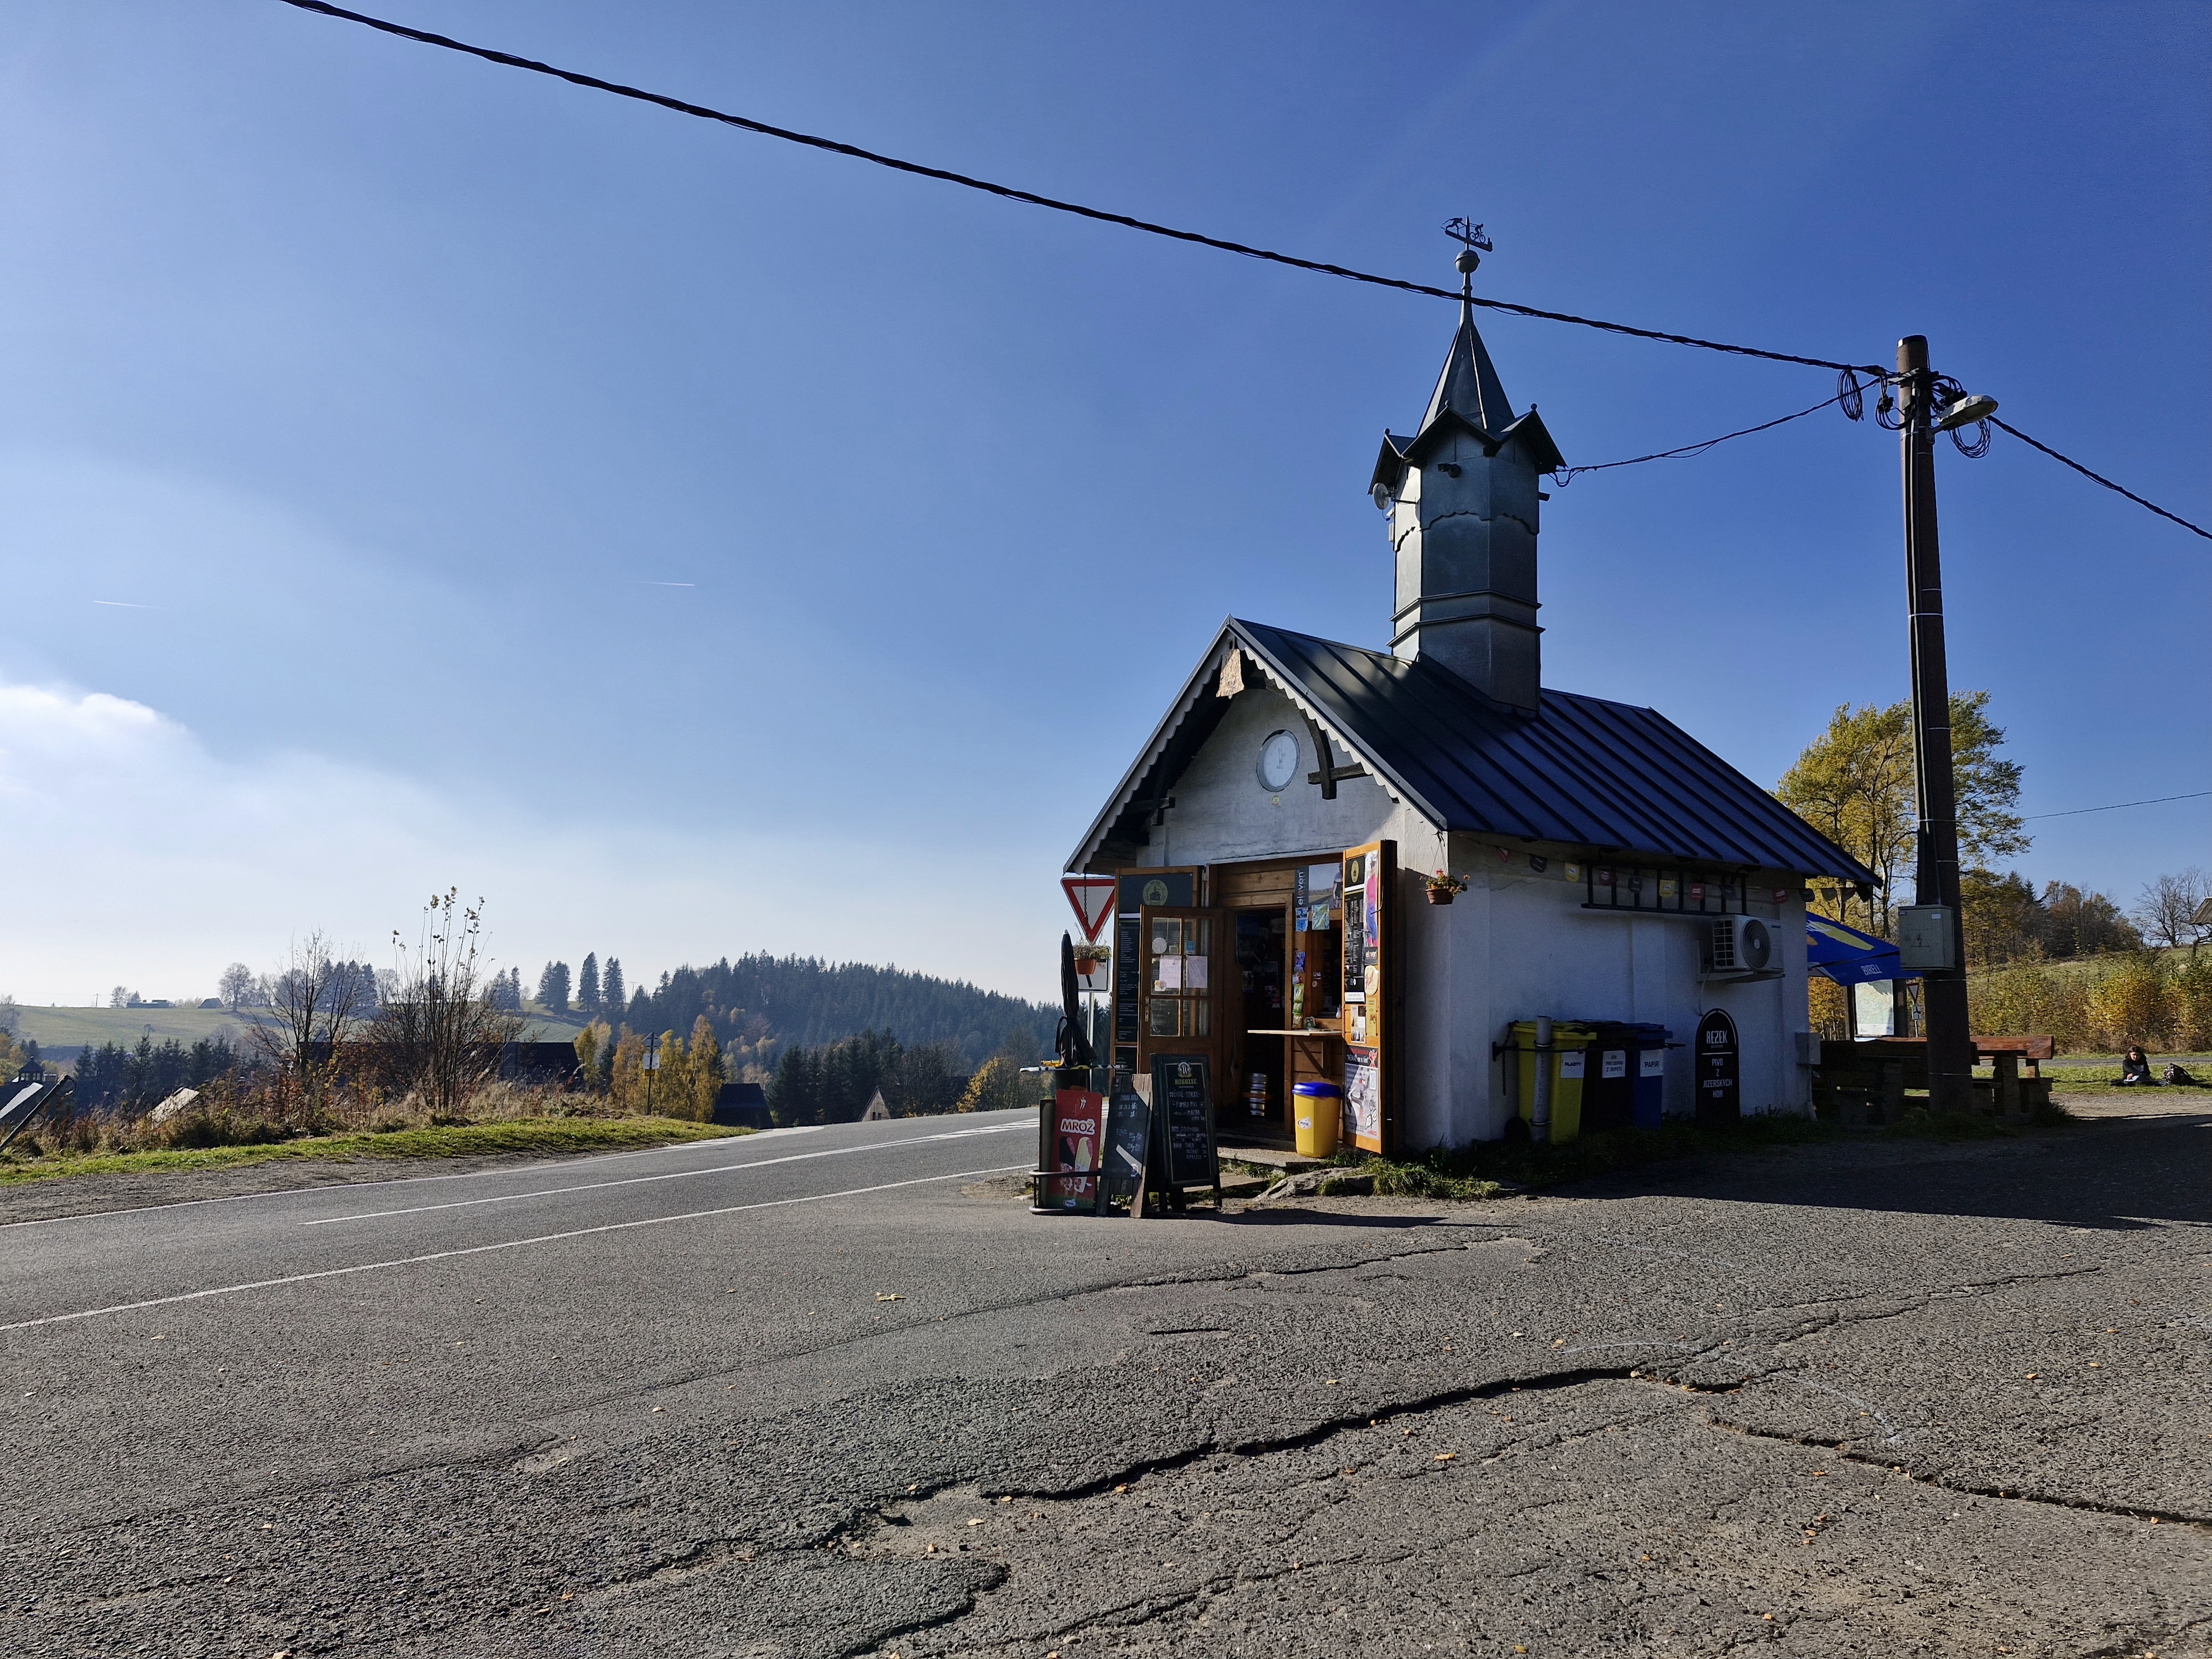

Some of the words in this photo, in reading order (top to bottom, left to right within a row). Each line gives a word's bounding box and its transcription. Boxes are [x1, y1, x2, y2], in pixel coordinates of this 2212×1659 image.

[1712, 1058, 1723, 1066] PIVO
[1715, 1068, 1720, 1077] Z
[1703, 1078, 1733, 1088] JIZERSKÝCH
[1062, 1120, 1094, 1133] MROŽ
